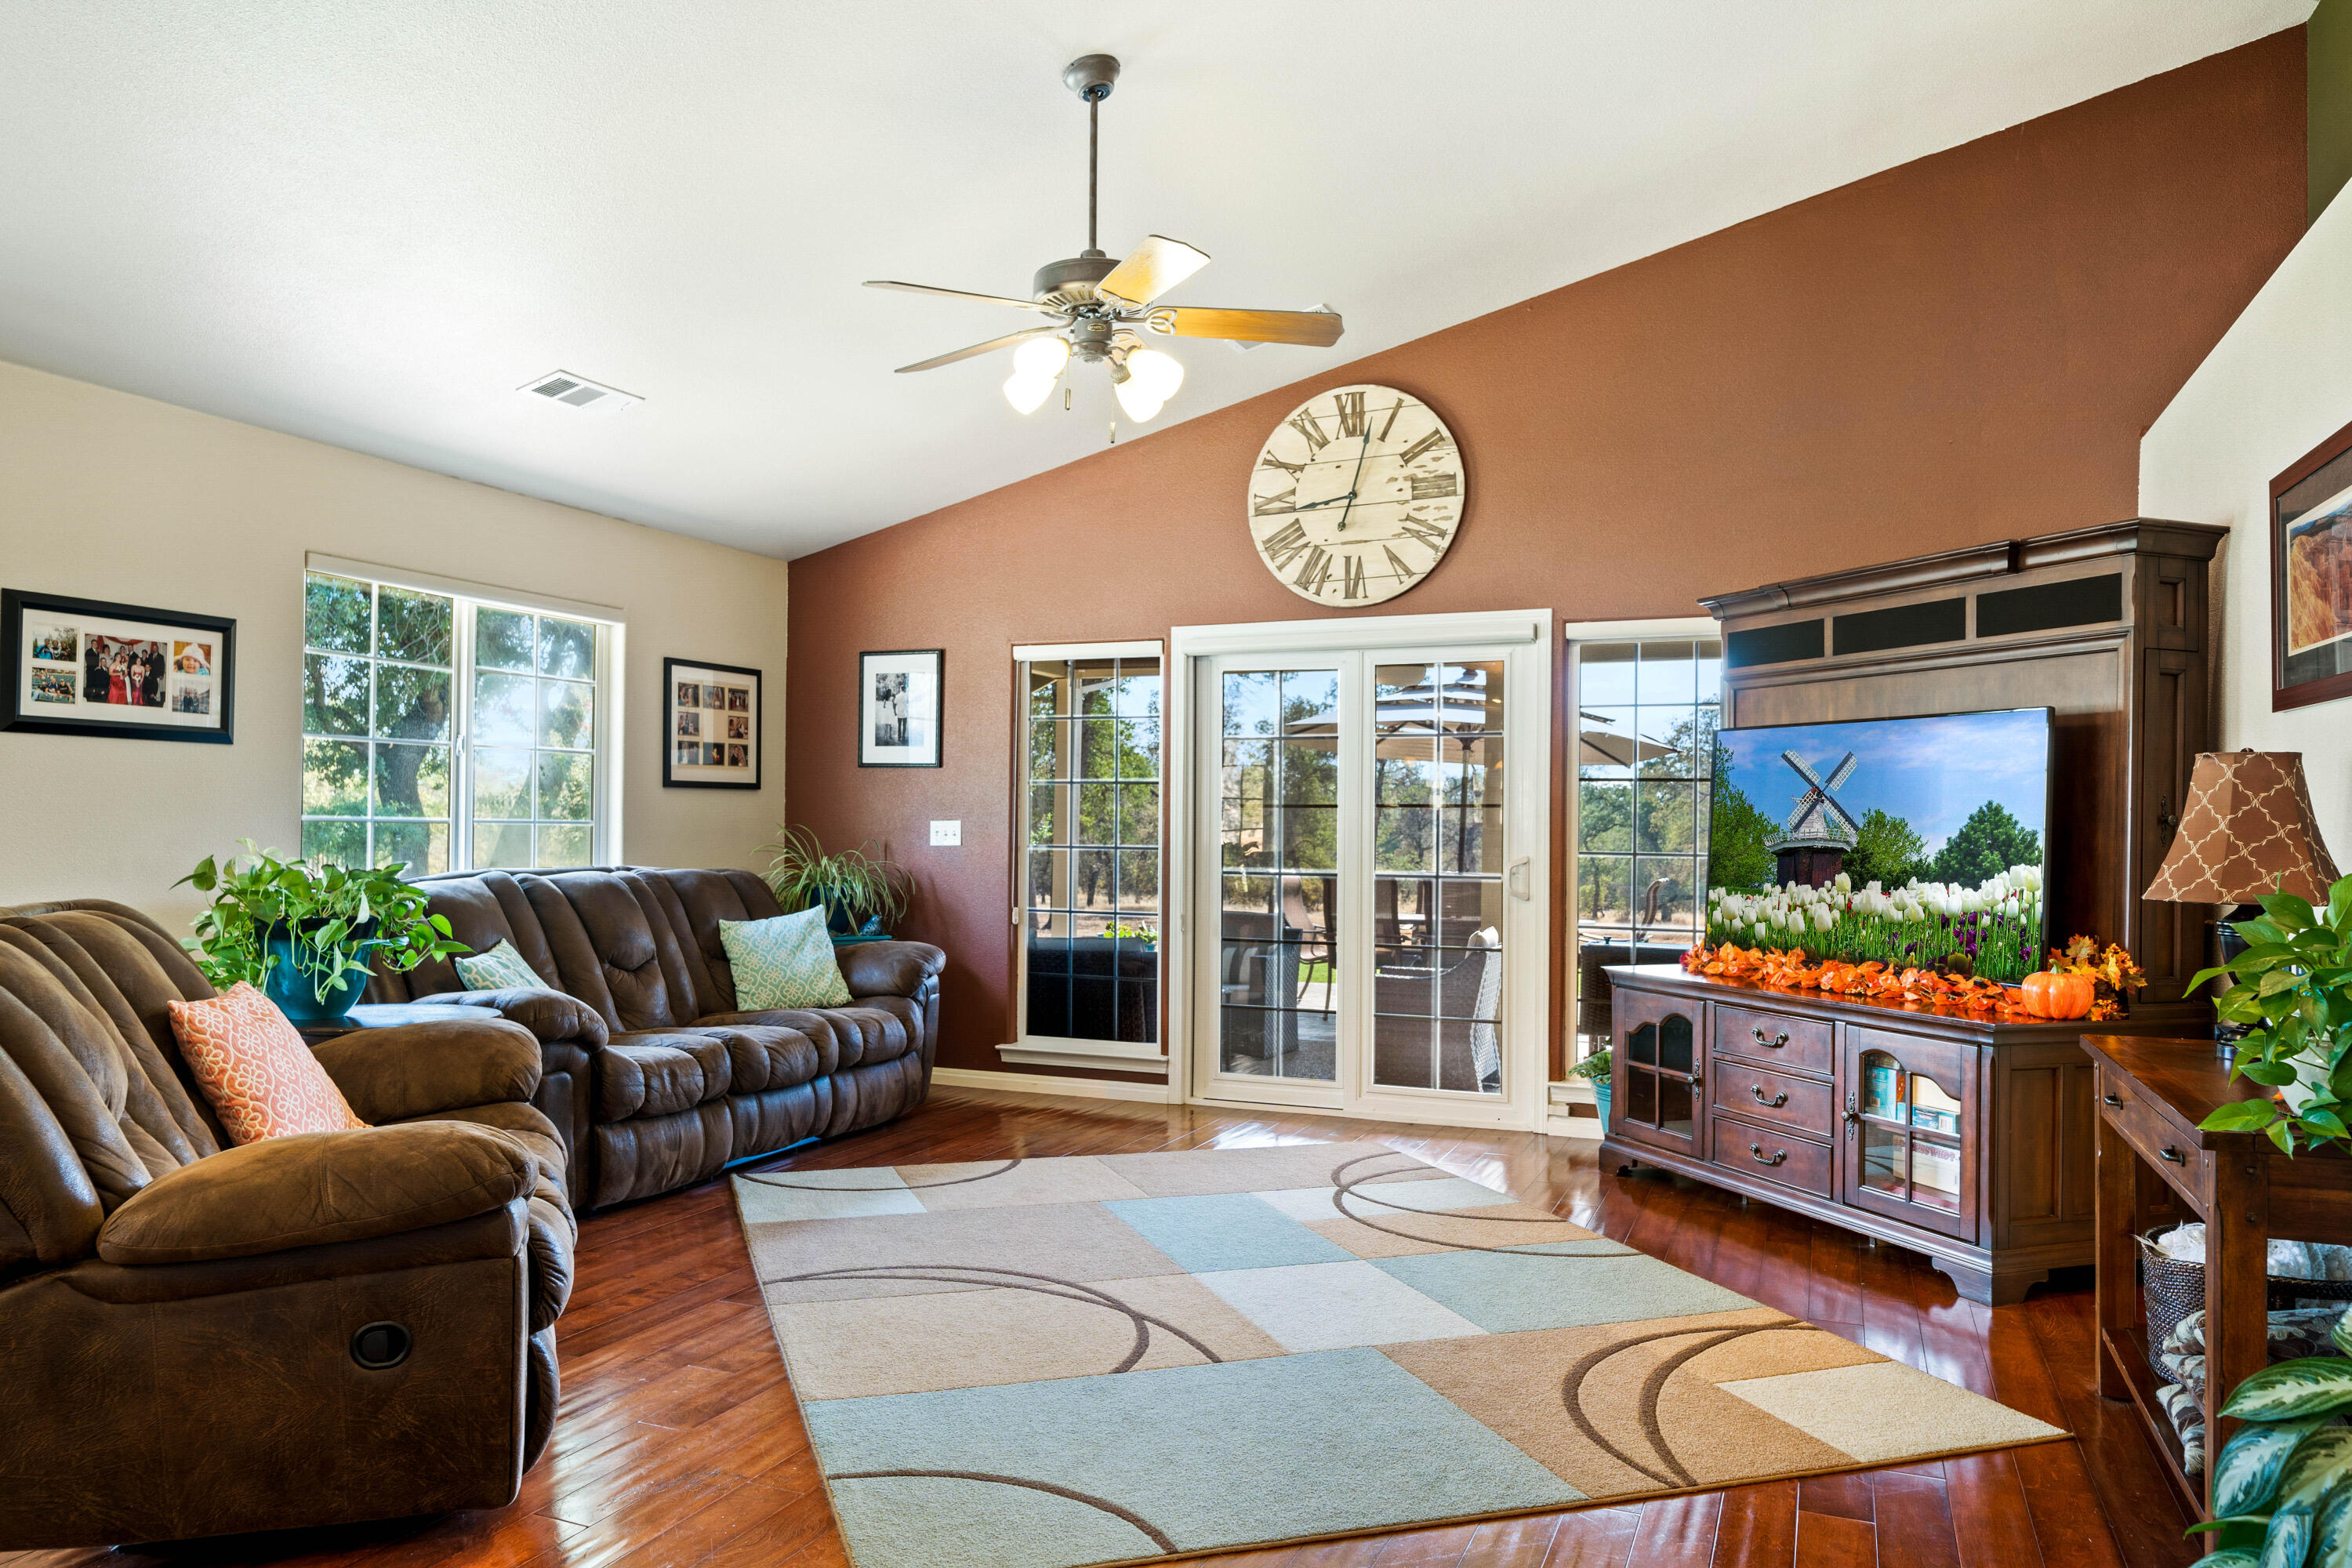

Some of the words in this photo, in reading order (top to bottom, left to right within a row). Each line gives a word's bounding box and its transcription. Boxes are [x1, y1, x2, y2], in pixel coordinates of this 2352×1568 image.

[1289, 407, 1331, 456] XI
[1334, 391, 1367, 440] XII
[1377, 397, 1404, 442] I
[1261, 449, 1306, 483] X
[1399, 426, 1445, 466] II
[1254, 487, 1296, 517] IX
[1410, 472, 1457, 500] III
[1261, 517, 1312, 572] VIII
[1383, 544, 1416, 585] V
[1294, 544, 1333, 597] VII
[1343, 555, 1369, 599] VI
